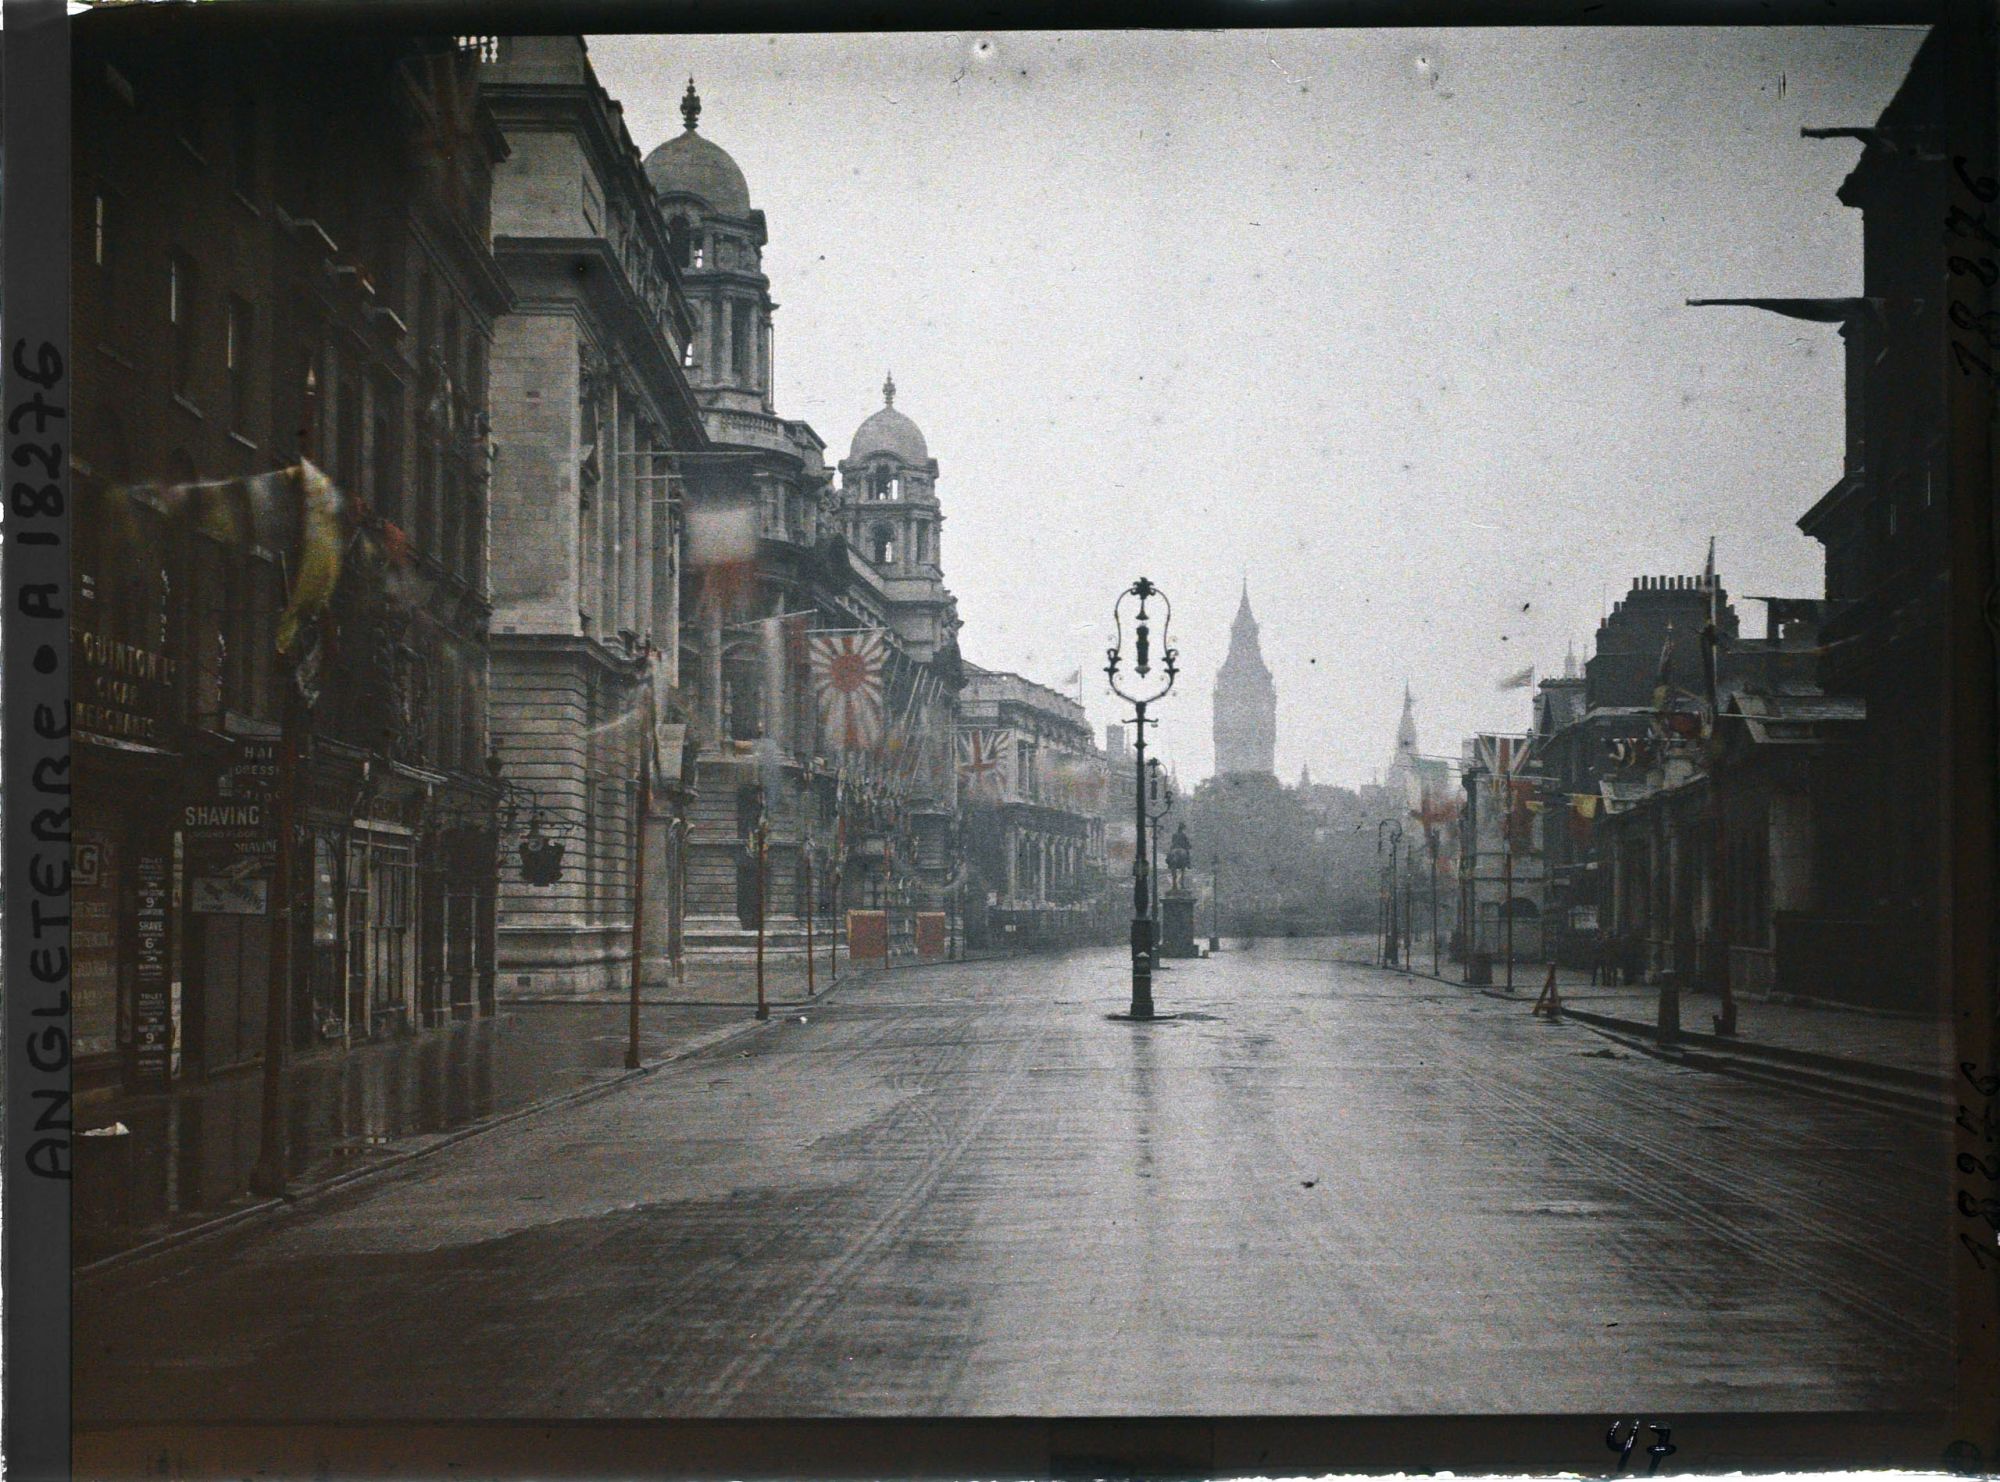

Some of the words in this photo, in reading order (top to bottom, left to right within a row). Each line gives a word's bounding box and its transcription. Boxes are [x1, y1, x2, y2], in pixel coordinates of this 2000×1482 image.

[8, 338, 66, 546] 18276
[18, 583, 65, 619] A
[244, 746, 273, 760] HAI
[185, 805, 261, 827] SHAVING
